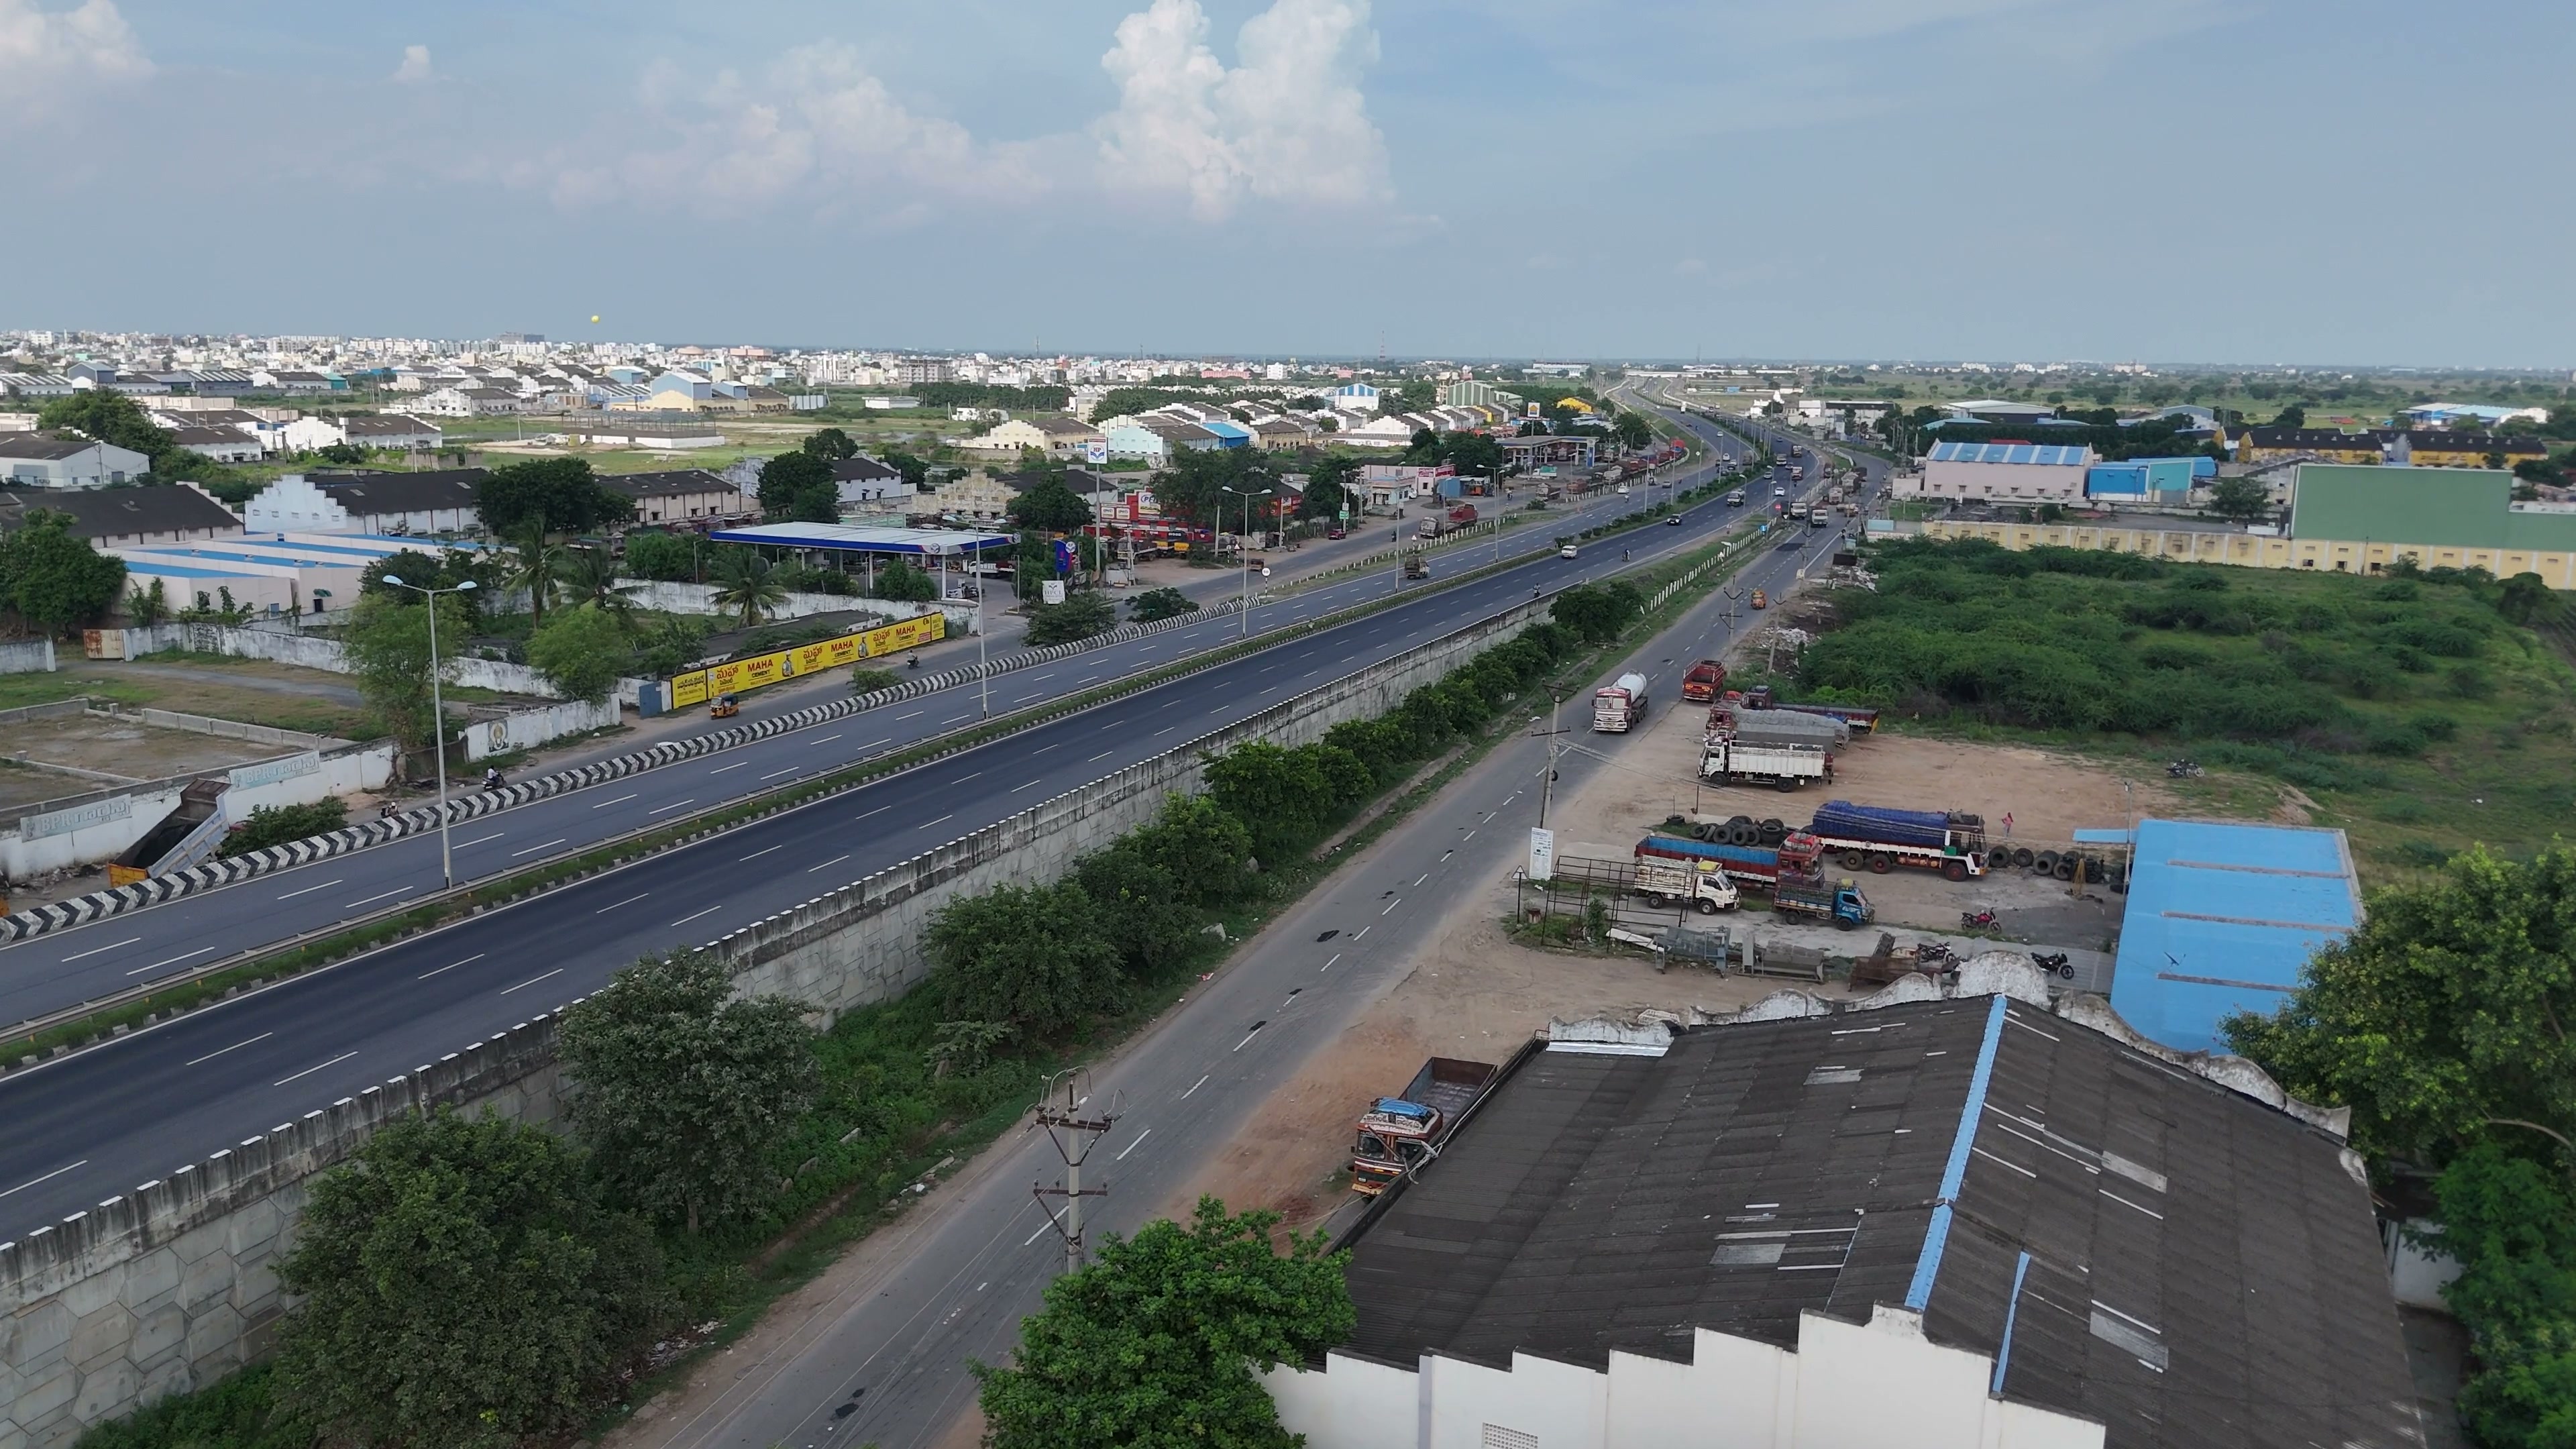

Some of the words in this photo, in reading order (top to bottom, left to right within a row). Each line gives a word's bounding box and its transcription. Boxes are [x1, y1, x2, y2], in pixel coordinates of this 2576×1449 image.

[873, 629, 891, 641] మహా
[896, 625, 916, 636] MAHA
[803, 645, 823, 659] మహా
[830, 640, 853, 652] MAHA
[716, 665, 740, 679] మహా
[747, 659, 773, 672] MAHA
[751, 669, 770, 678] CEMENT
[246, 766, 272, 784] BPR
[40, 812, 72, 833] BPR
